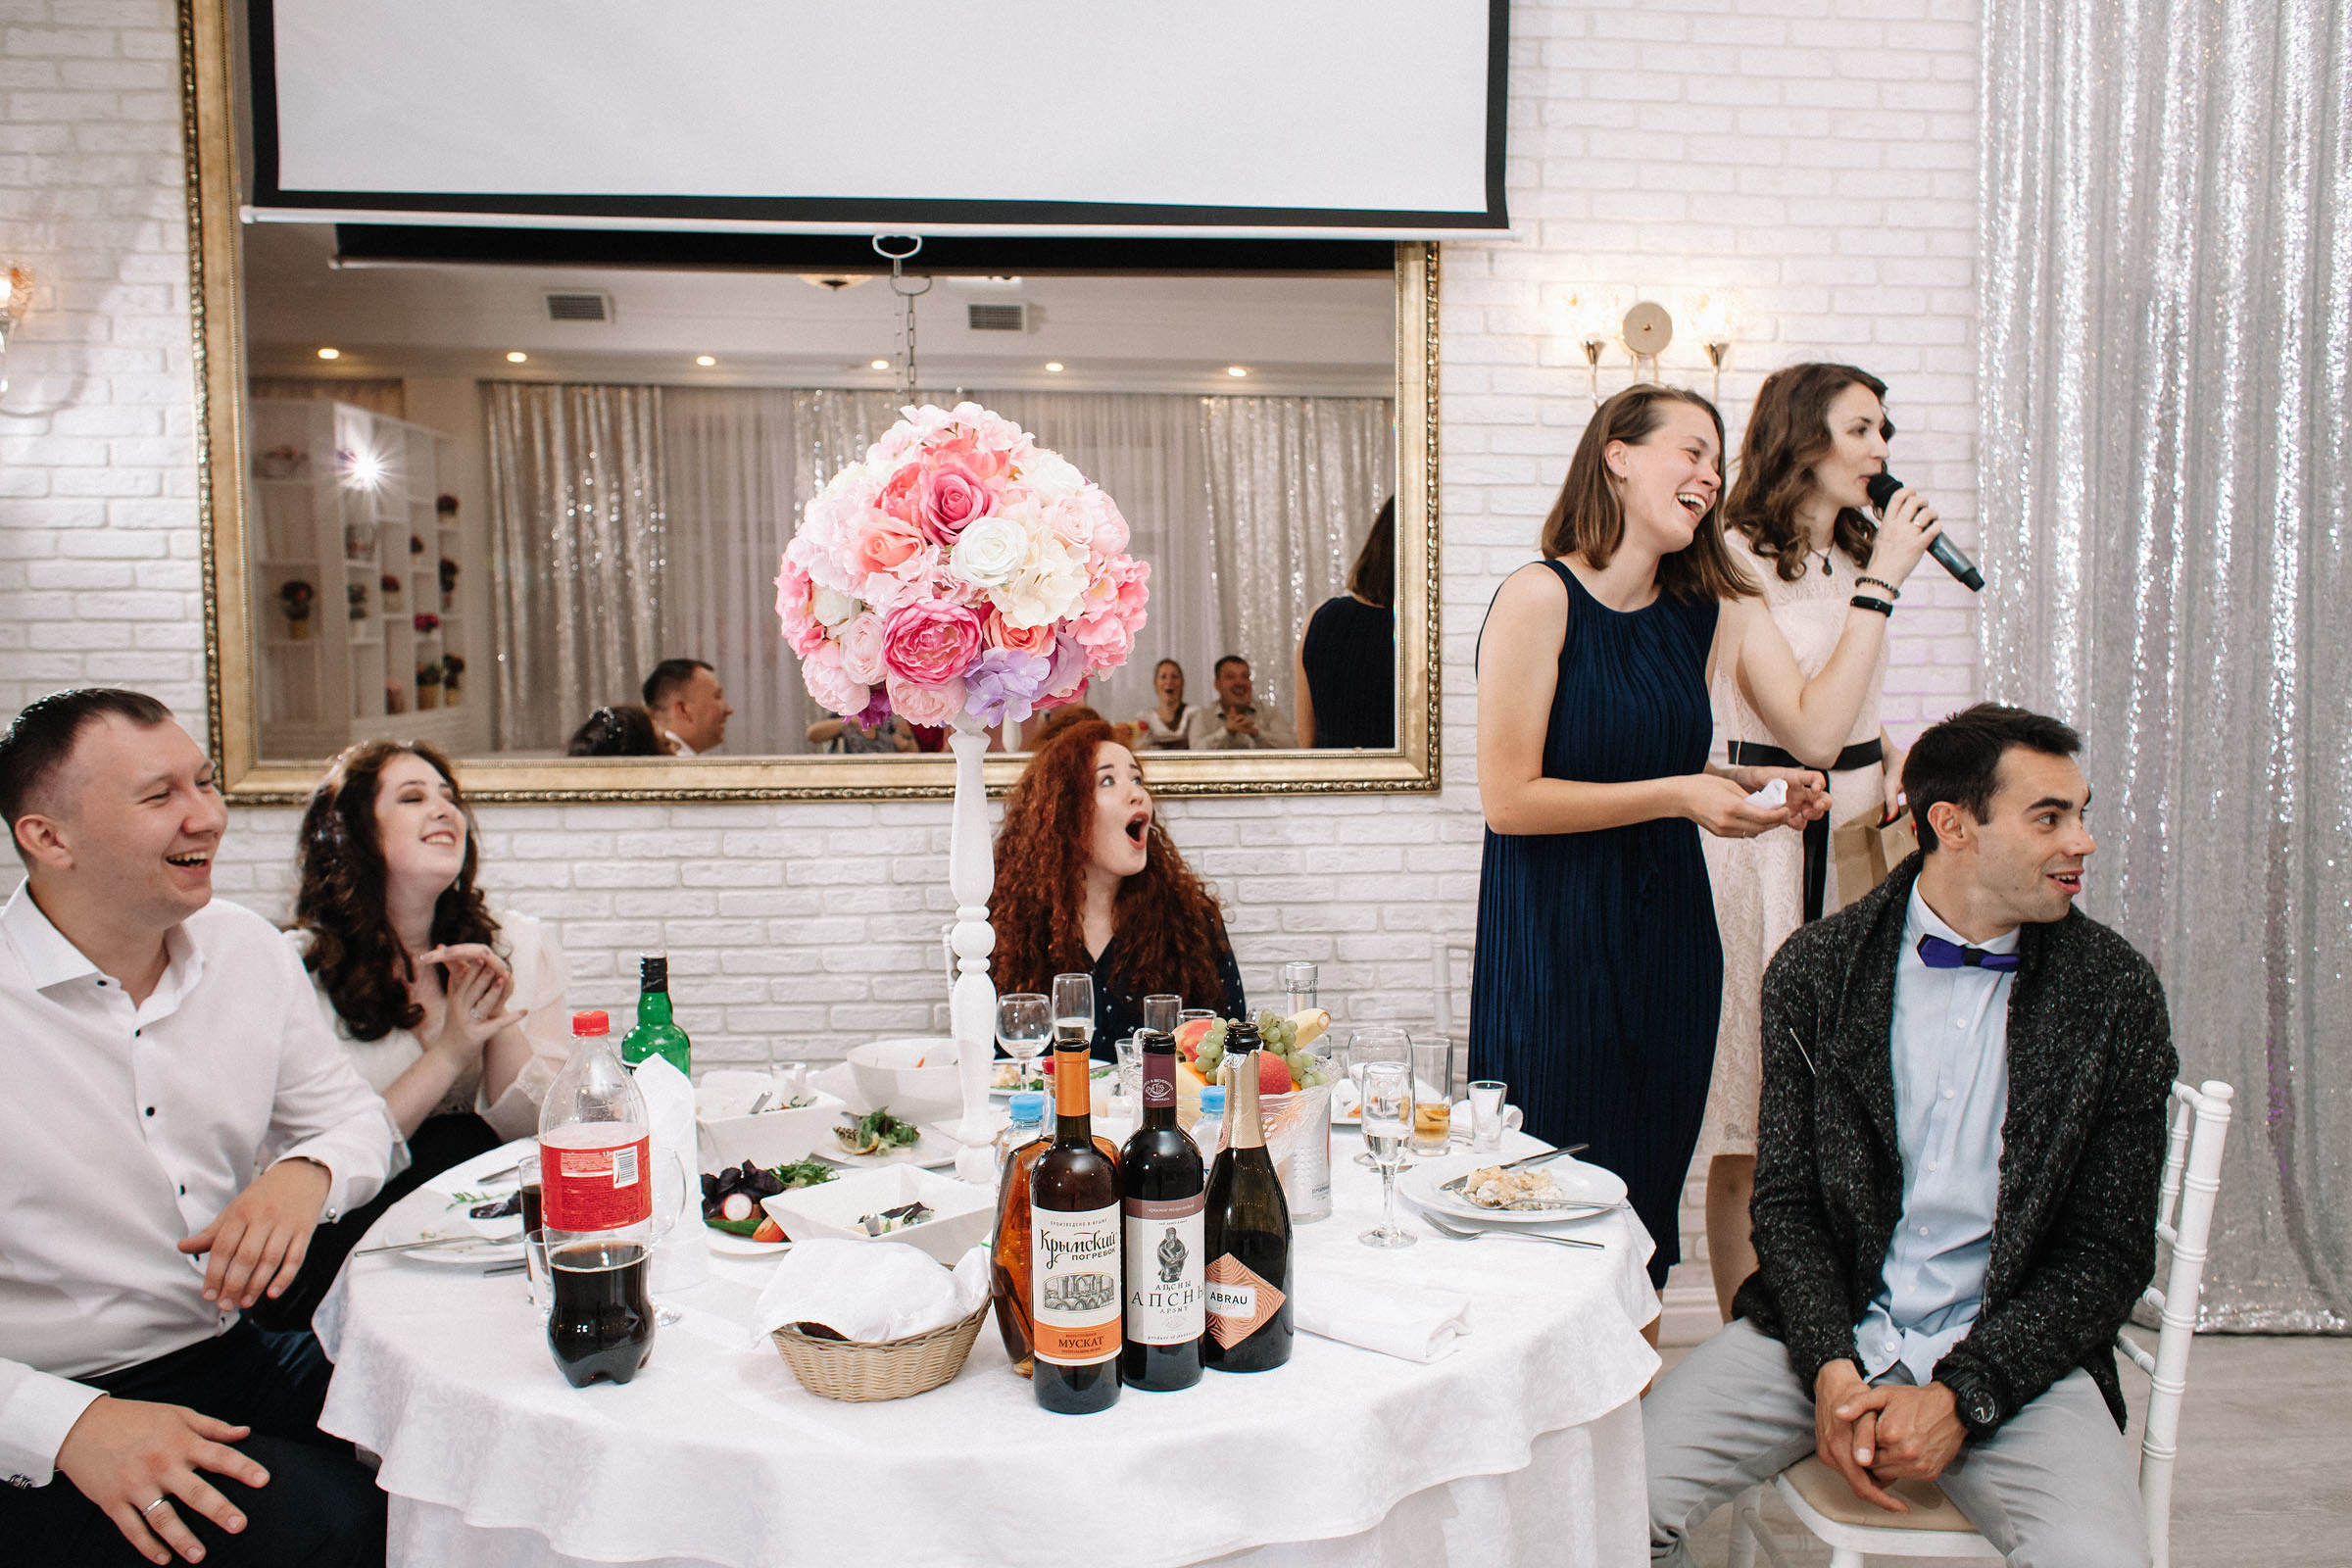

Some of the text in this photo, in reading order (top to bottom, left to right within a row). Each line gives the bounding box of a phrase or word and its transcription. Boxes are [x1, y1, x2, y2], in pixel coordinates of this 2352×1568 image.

[1040, 1229, 1116, 1270] Крымский
[1071, 1246, 1116, 1261] ПОГРЕБОК
[1209, 1292, 1249, 1305] ABRAU
[1058, 1336, 1104, 1348] МУСКАТ
